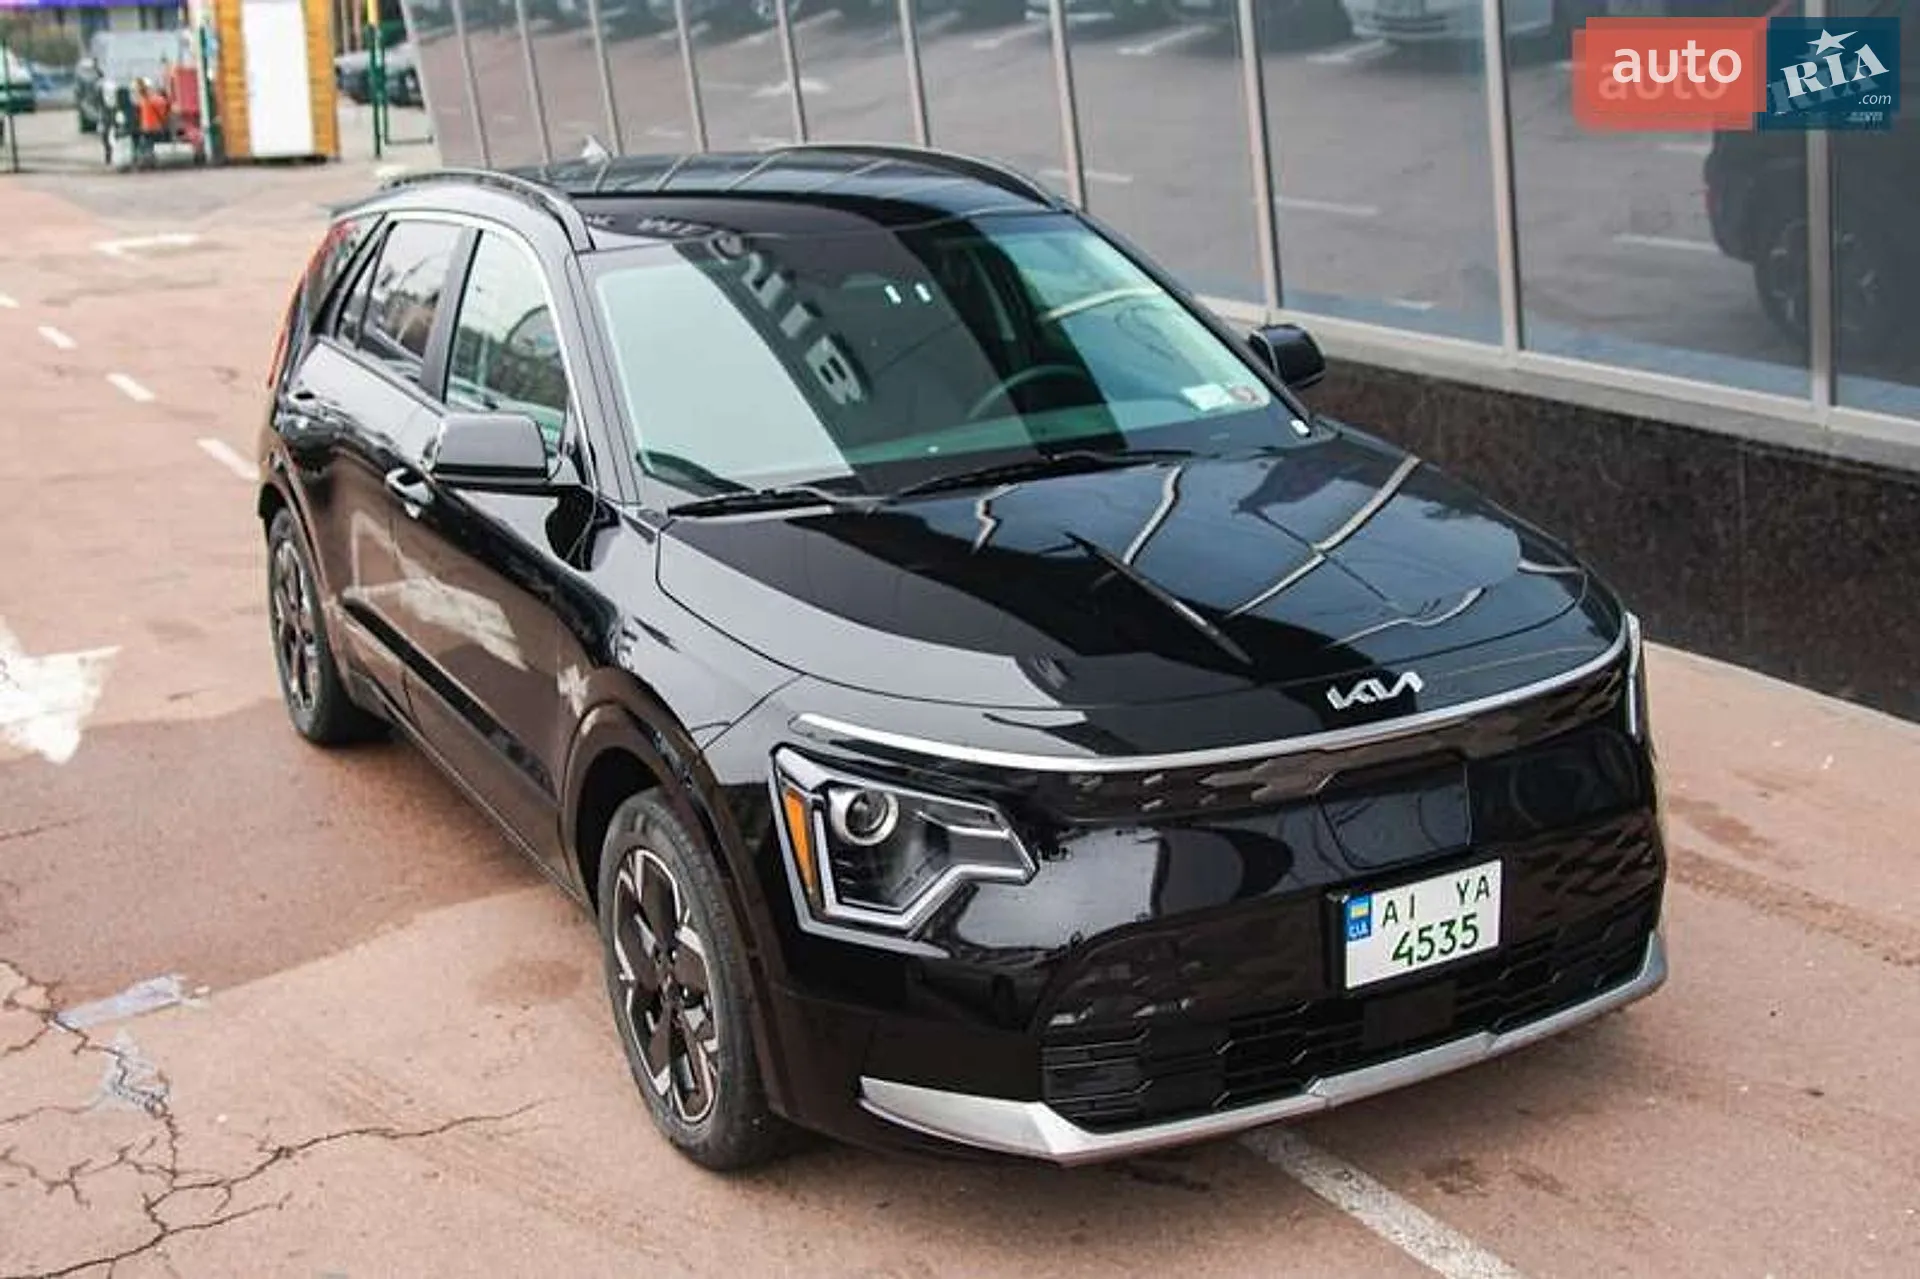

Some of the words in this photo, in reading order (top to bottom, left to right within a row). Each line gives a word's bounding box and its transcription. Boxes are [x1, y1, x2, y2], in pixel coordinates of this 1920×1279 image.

[1326, 671, 1424, 710] KIA
[1381, 893, 1416, 927] AI
[1456, 875, 1490, 905] YA
[1391, 912, 1480, 966] 4535
